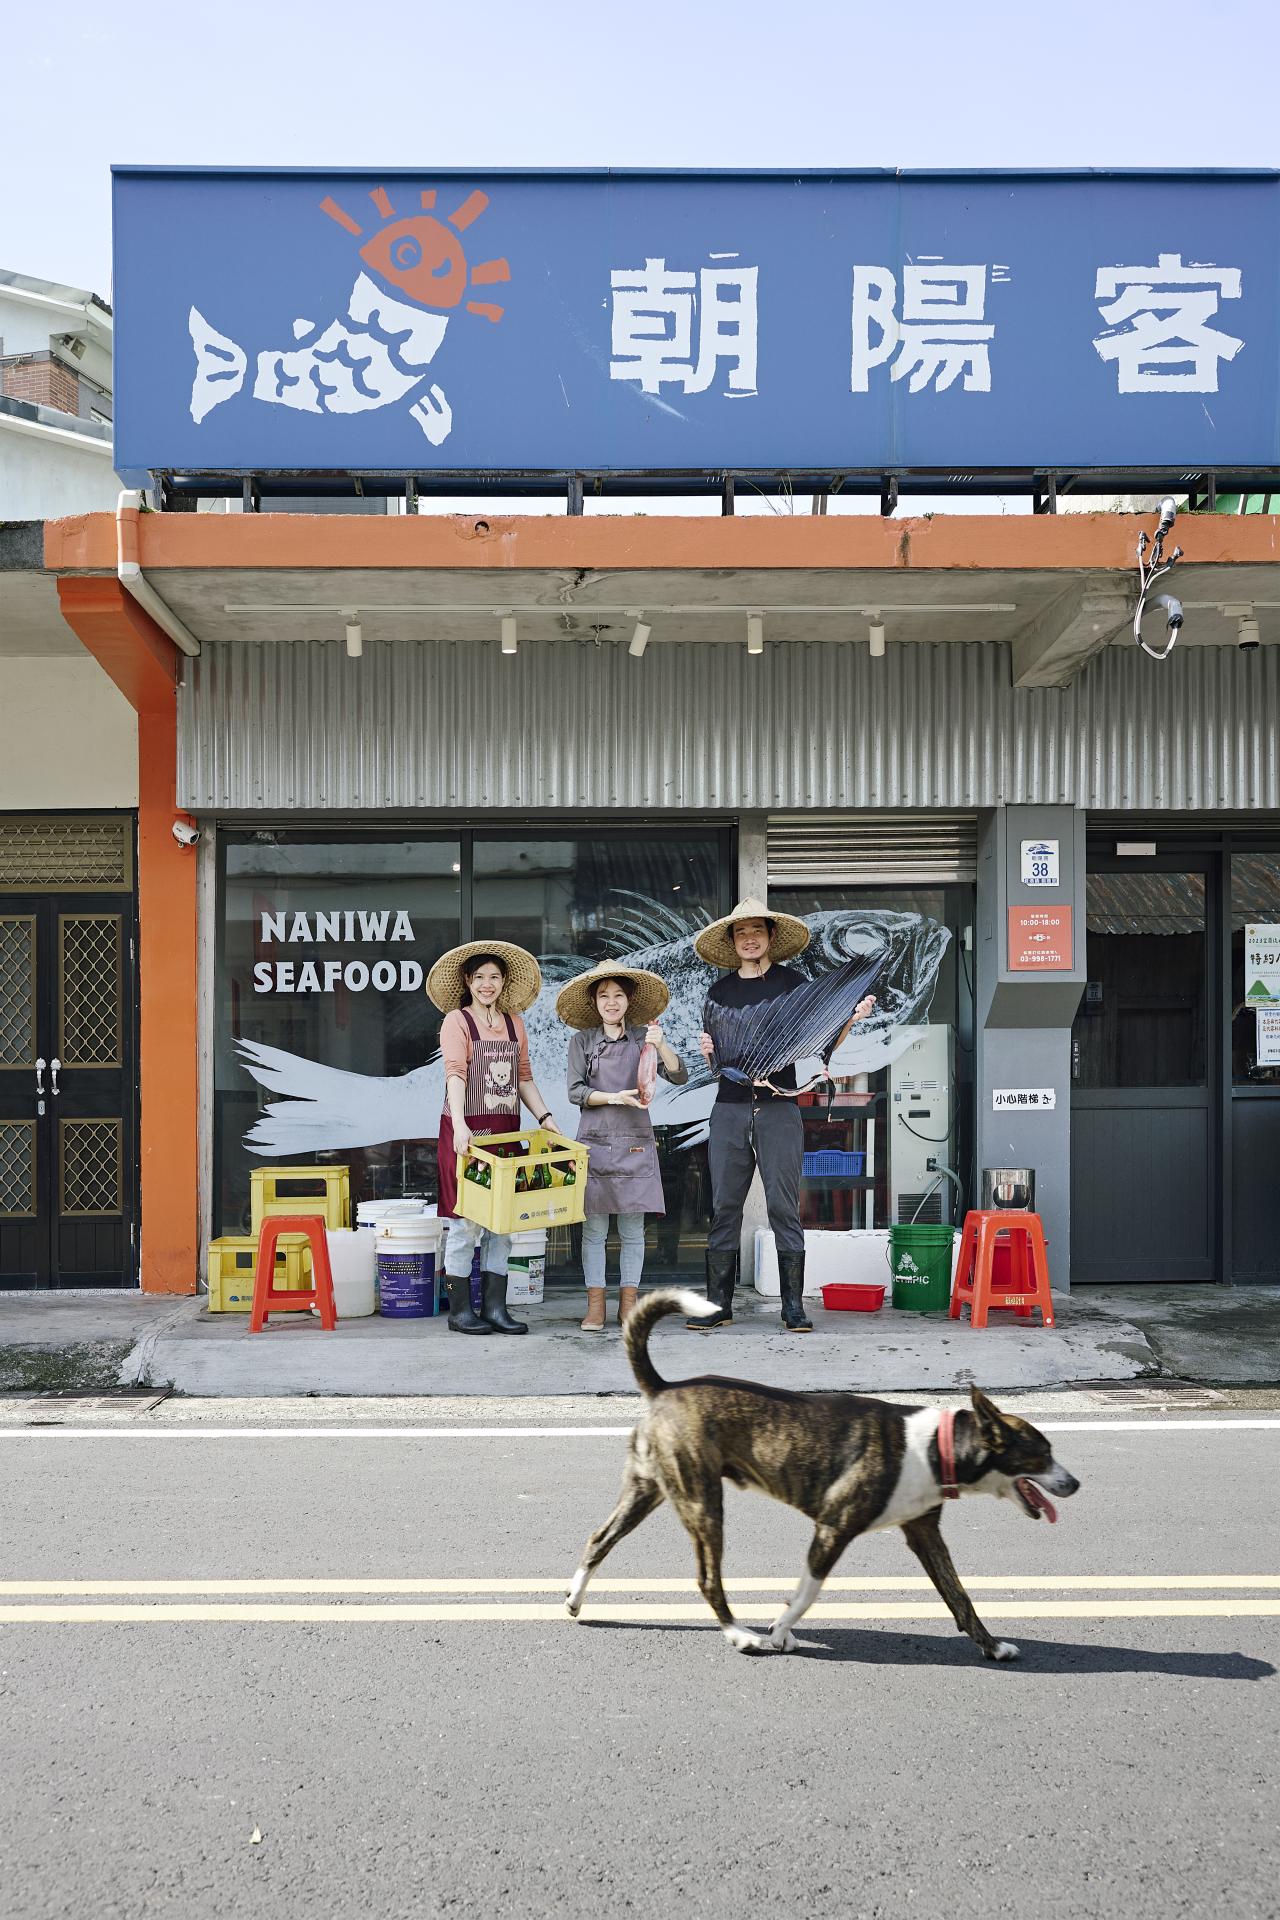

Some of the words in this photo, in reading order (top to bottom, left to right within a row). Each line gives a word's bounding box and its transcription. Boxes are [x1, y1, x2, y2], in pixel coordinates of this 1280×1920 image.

[609, 252, 1246, 398] 朝陽客
[1032, 862, 1048, 877] 38
[260, 910, 416, 943] NANIWA
[253, 960, 424, 993] SEAFOOD
[995, 1093, 1039, 1104] 小心階梯
